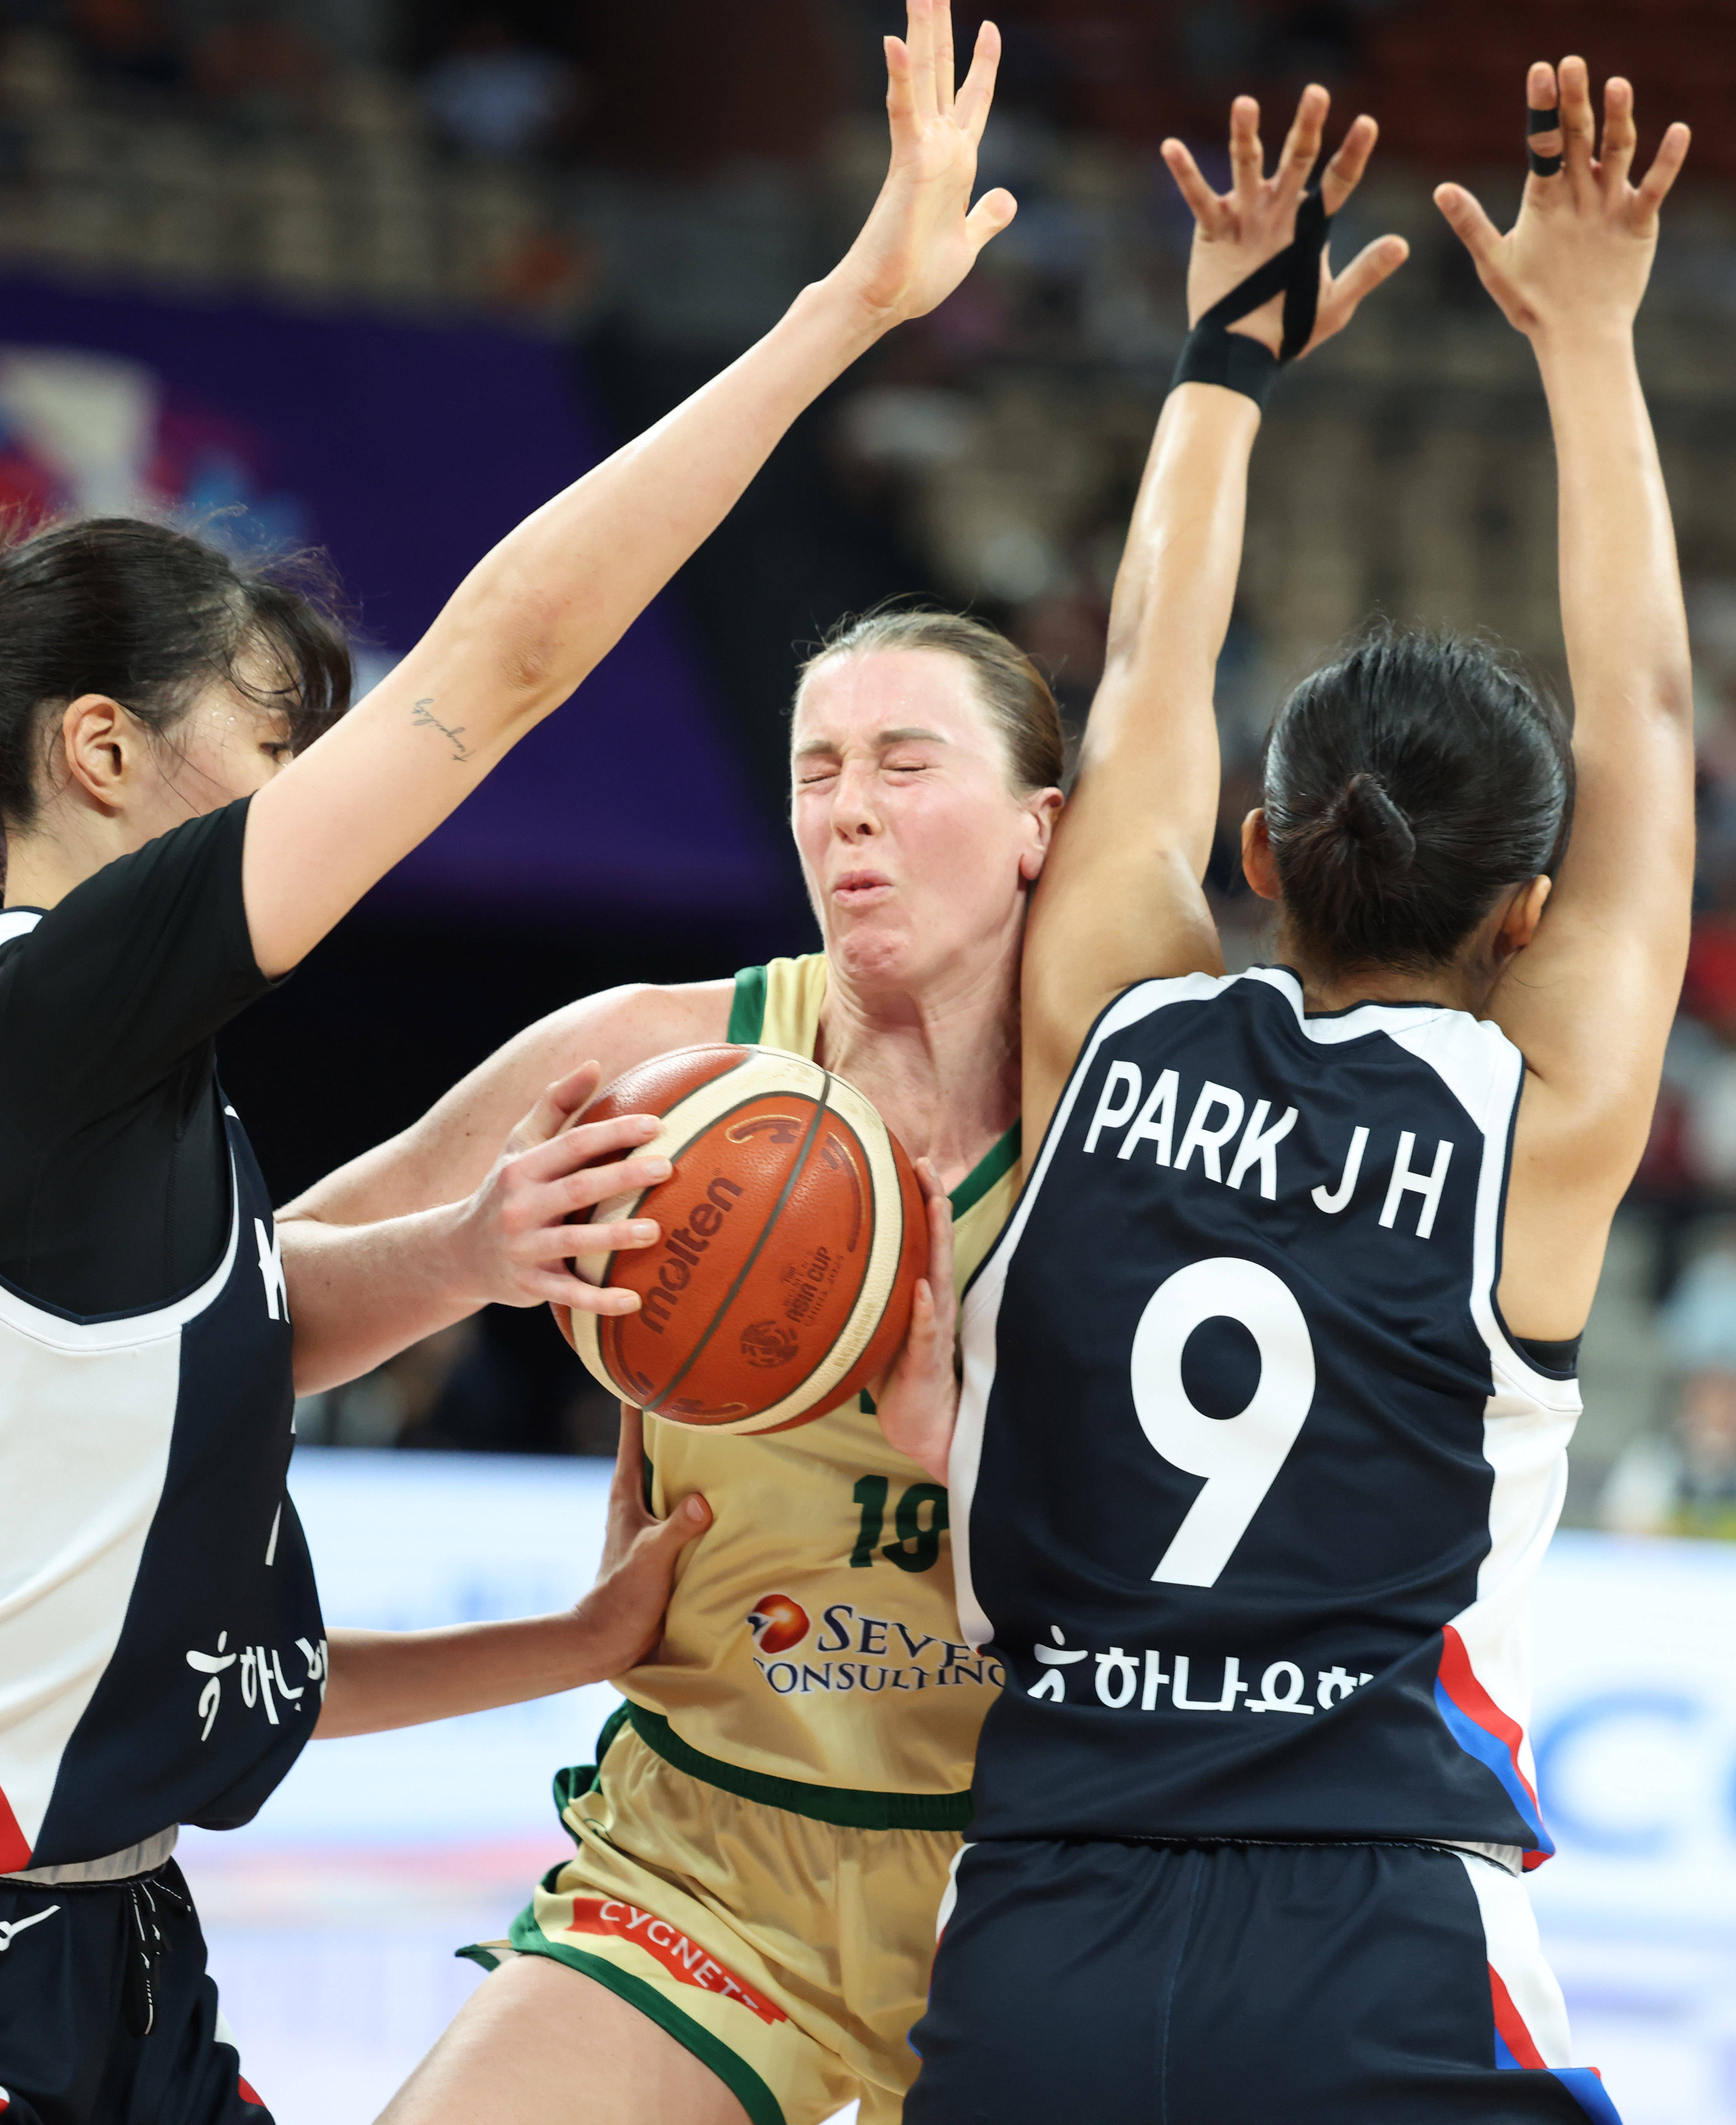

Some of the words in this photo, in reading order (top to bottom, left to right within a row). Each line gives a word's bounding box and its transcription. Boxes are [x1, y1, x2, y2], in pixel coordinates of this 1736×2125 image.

[1083, 1060, 1299, 1201] PARK
[1311, 1126, 1370, 1213] J
[1378, 1131, 1454, 1239] H
[639, 1178, 744, 1334] molten
[806, 1246, 831, 1282] CUP
[1130, 1257, 1316, 1588] 9
[850, 1474, 950, 1573] 19
[752, 1656, 1005, 1693] ONSULTIN
[818, 1604, 971, 1668] SEVE
